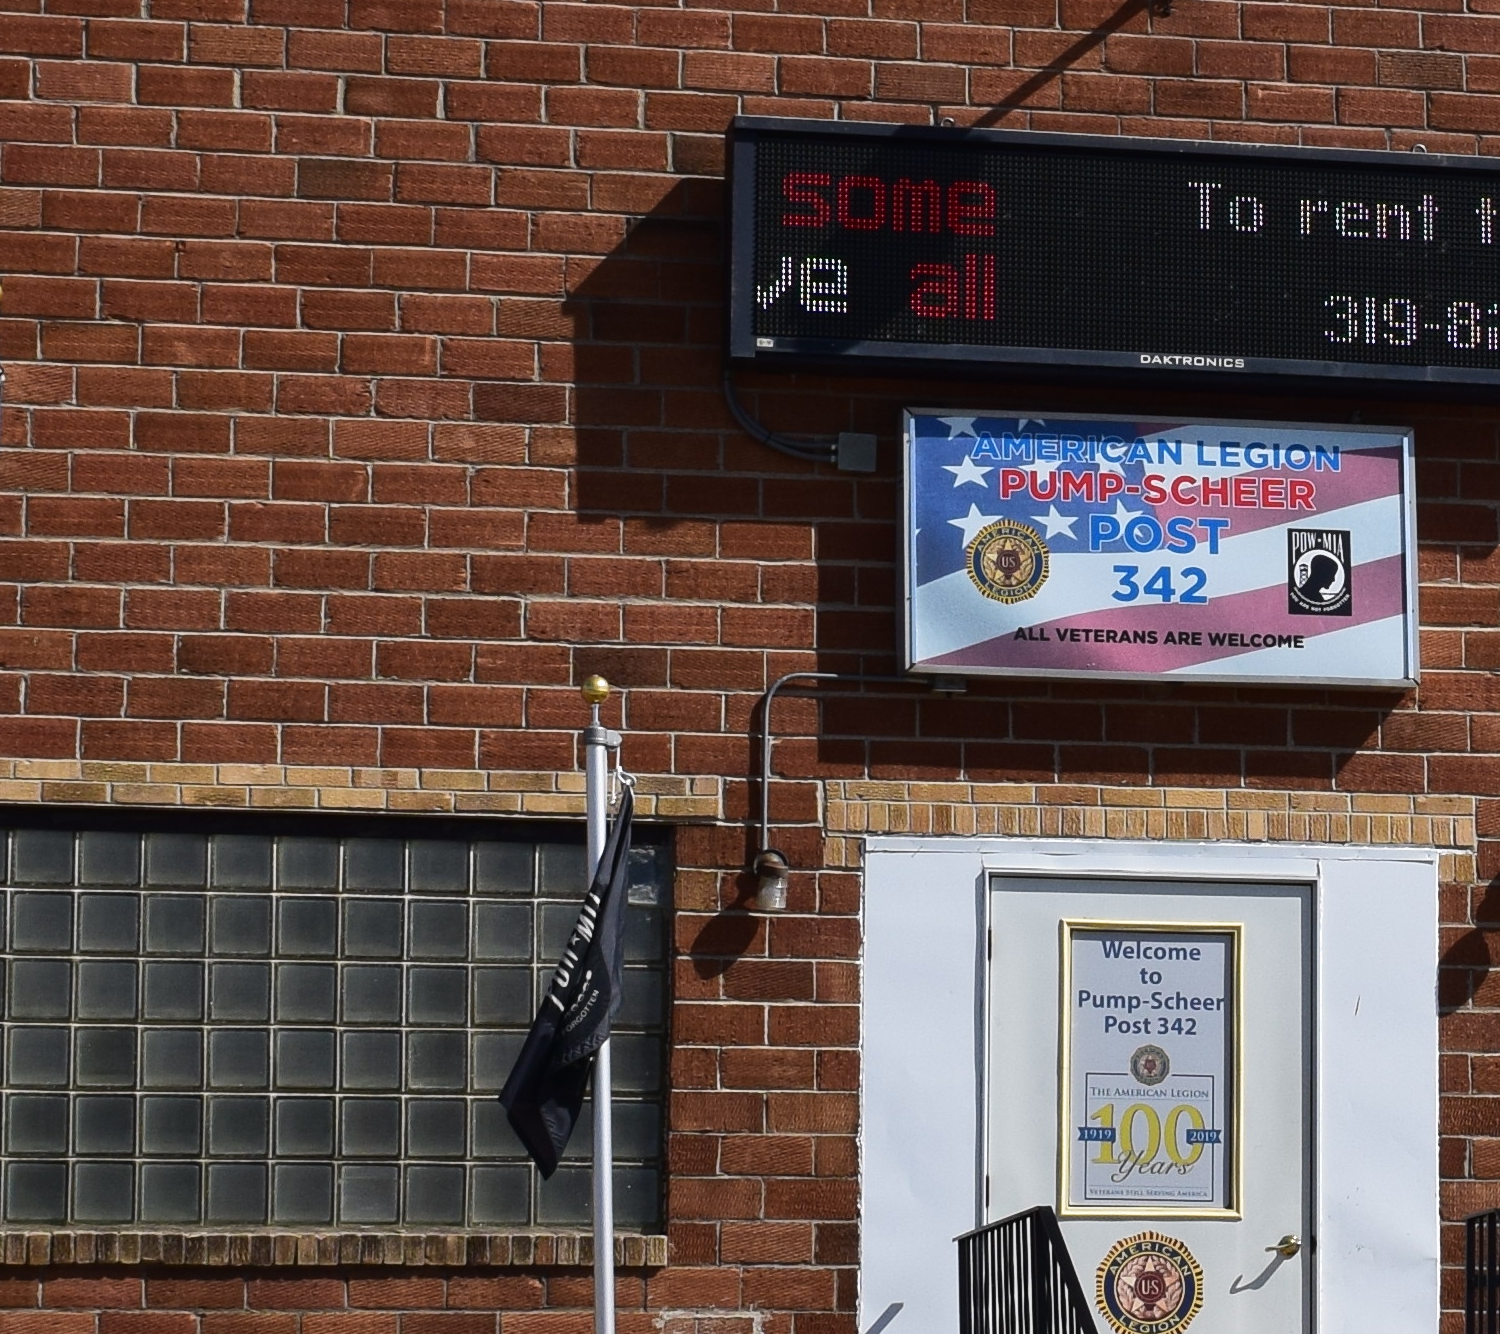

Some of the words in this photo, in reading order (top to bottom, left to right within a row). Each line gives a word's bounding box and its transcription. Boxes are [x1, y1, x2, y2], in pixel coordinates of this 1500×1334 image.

[783, 173, 995, 236] some
[1188, 181, 1264, 232] To
[1300, 194, 1439, 241] rent
[910, 253, 995, 320] all
[1140, 354, 1245, 368] DAKTRONICS
[972, 431, 1183, 468] AMERICAN
[1195, 439, 1341, 472] LEGION
[1000, 469, 1317, 511] PUMP-SCHEER
[977, 528, 1041, 554] AMERICAN
[1090, 513, 1231, 556] POST
[984, 581, 1033, 597] LEGION
[1111, 565, 1209, 605] 342
[1013, 627, 1051, 643] ALL
[1056, 628, 1159, 646] VETERANS
[1164, 630, 1203, 648] ARE
[1207, 631, 1305, 650] WELCOME
[1101, 941, 1201, 961] Welcome
[1139, 967, 1162, 984] to
[562, 988, 600, 1035] ORGOTTEN
[1078, 989, 1225, 1014] Pump-Scheer
[1104, 1015, 1152, 1035] Post
[1157, 1017, 1197, 1036] 342
[1090, 1086, 1111, 1097] THE
[1113, 1087, 1168, 1098] AMERICAN
[1171, 1088, 1209, 1099] LEGION
[1083, 1128, 1112, 1140] 1919
[1090, 1102, 1206, 1166] 100
[1190, 1130, 1218, 1142] 2019
[1110, 1149, 1195, 1183] Years
[1109, 1242, 1193, 1277] AMERICAN
[1119, 1313, 1181, 1334] LEGION
